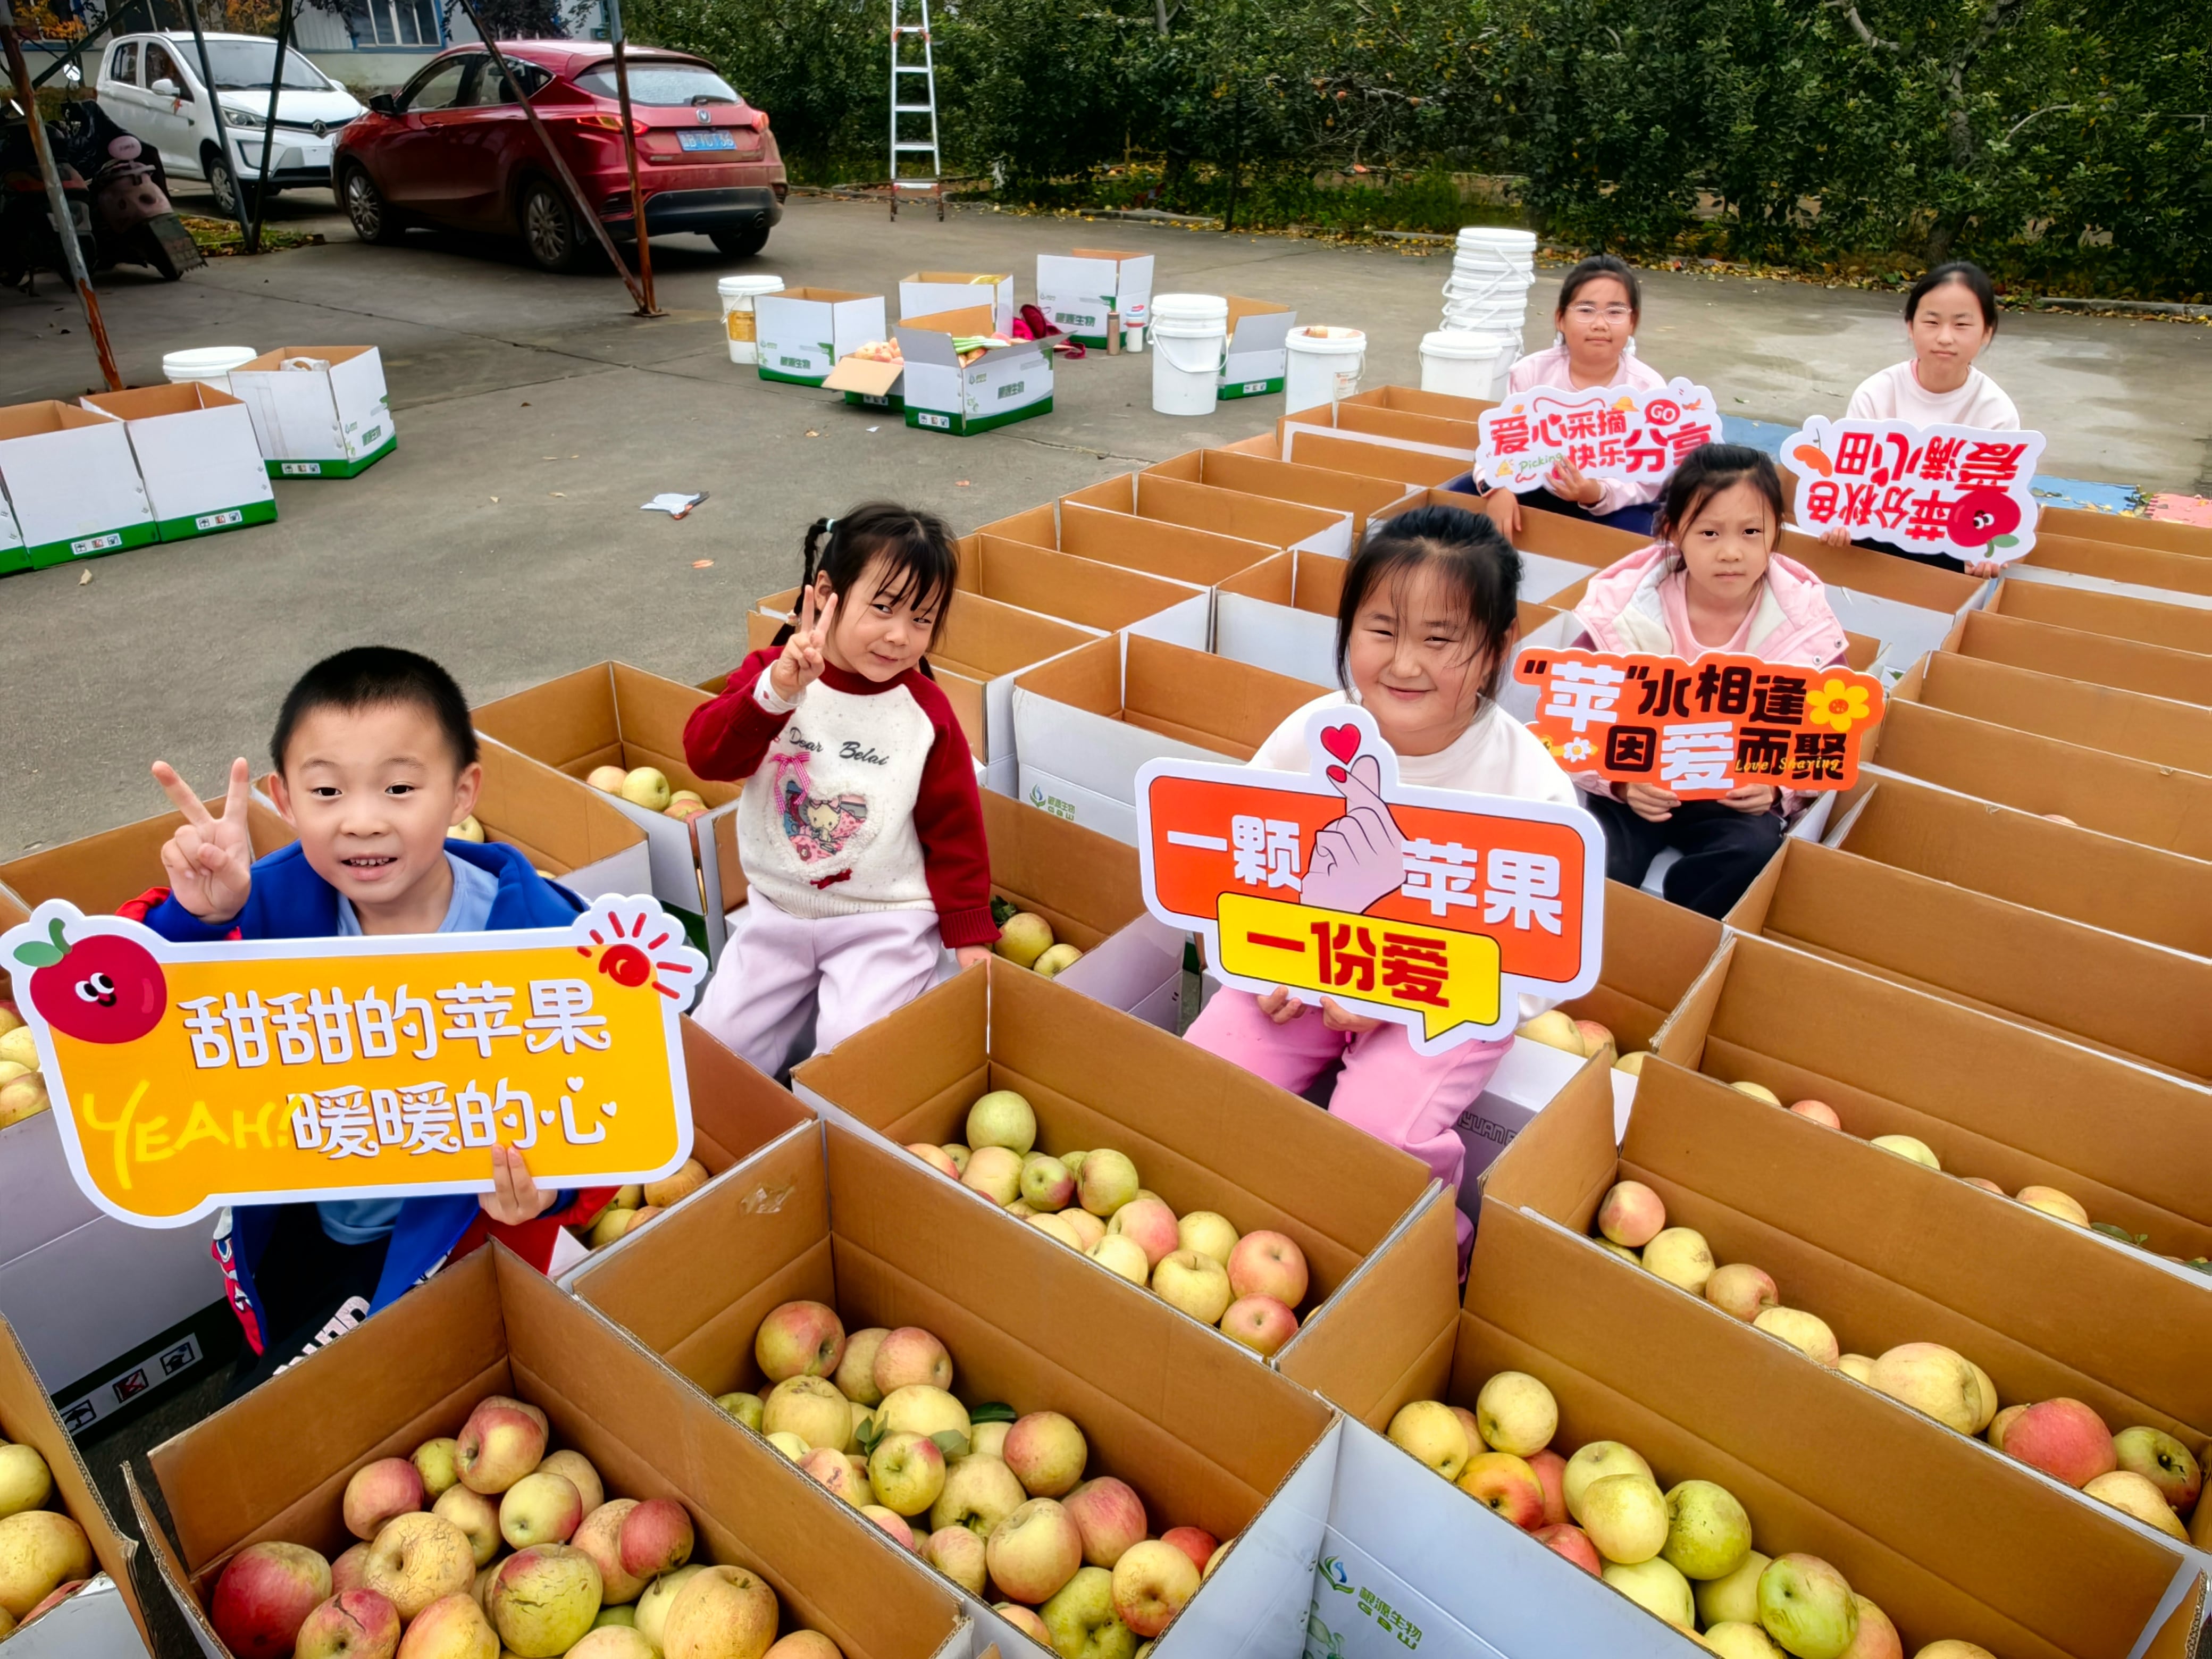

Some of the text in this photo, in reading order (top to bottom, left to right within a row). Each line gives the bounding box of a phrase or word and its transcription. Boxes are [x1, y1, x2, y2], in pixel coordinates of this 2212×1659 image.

[1490, 408, 1626, 456] 爱心采摘
[1650, 404, 1677, 423] GO
[1568, 422, 1712, 473] 快乐分享
[1834, 432, 2028, 492] 爱满心田
[1807, 481, 1955, 541] 苹分秋色
[789, 726, 824, 752] Dear
[1605, 722, 1847, 791] 因爱而聚
[1735, 757, 1840, 771] Love Sharing
[1247, 921, 1449, 1008] 一份爱
[178, 978, 611, 1069] 甜甜的苹果
[82, 1079, 303, 1190] YEAH!
[287, 1076, 617, 1159] 暖暖的心
[1457, 1111, 1505, 1144] YUAN
